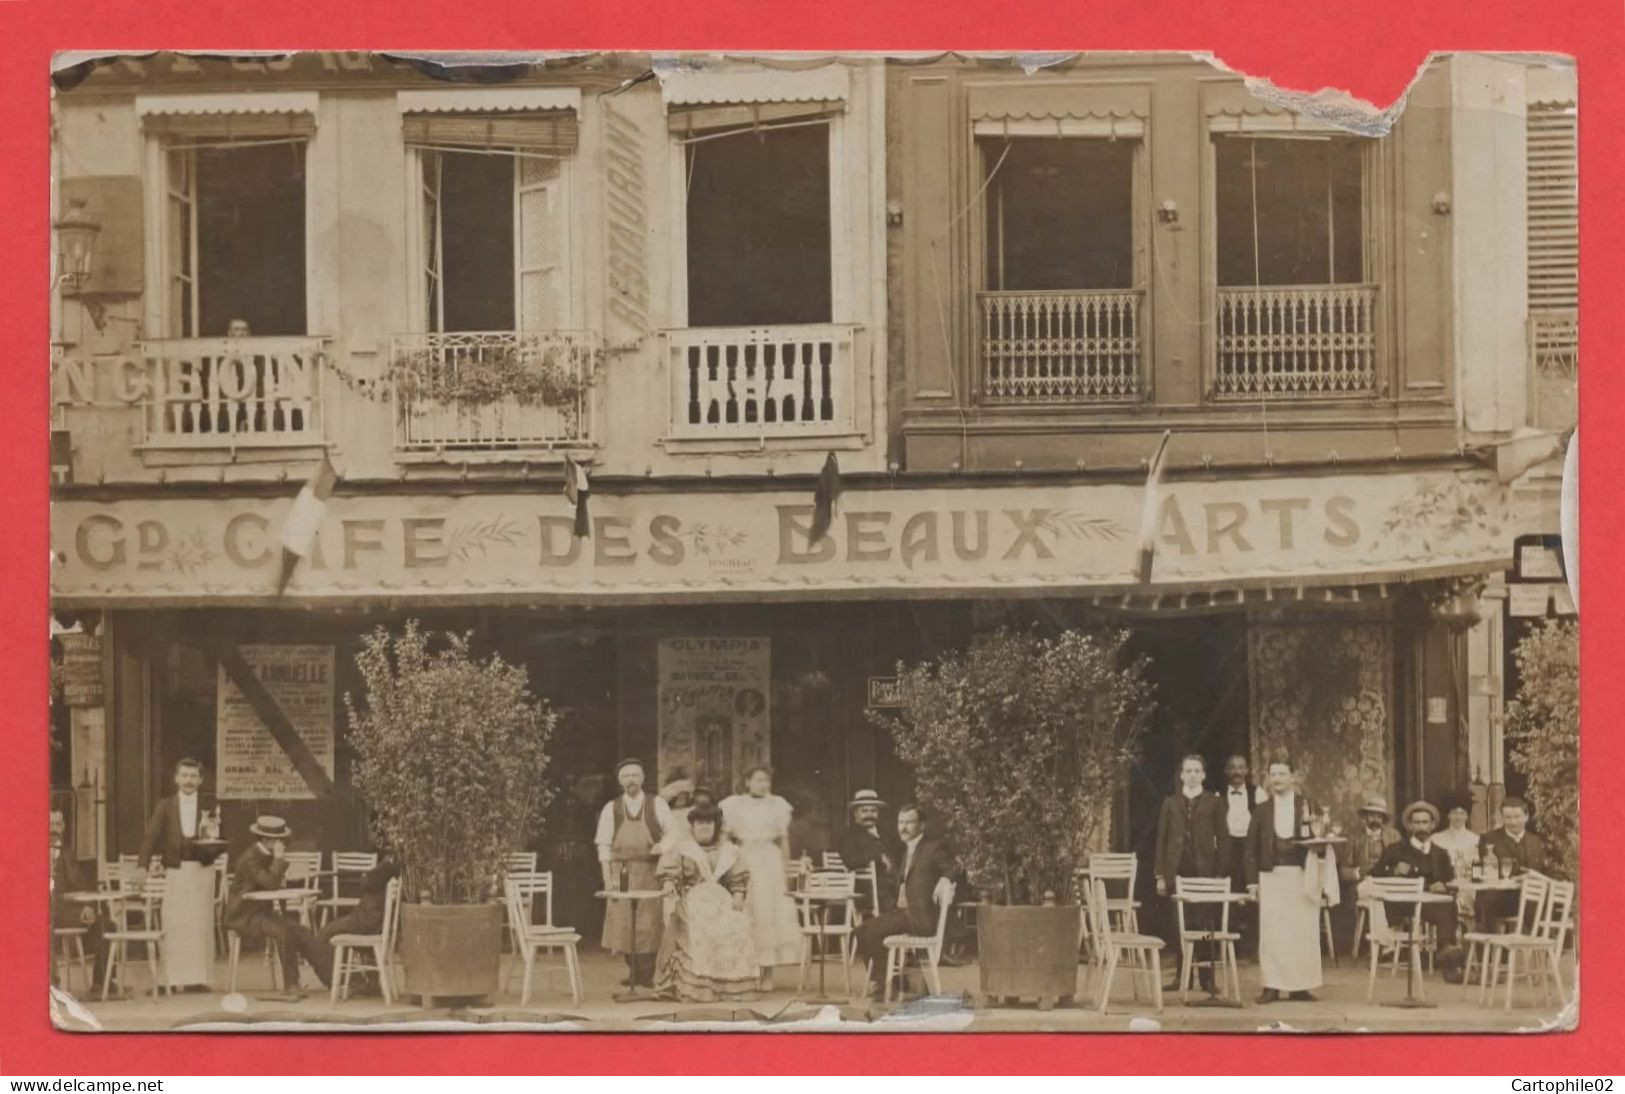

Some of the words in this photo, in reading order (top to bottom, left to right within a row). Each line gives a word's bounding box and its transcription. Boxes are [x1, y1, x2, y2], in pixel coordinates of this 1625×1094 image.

[602, 100, 650, 338] RESTAURANT
[538, 513, 686, 568] DES
[774, 504, 1057, 571] BEAUX
[1151, 493, 1361, 555] ARTS
[671, 639, 761, 651] OLYMPIA
